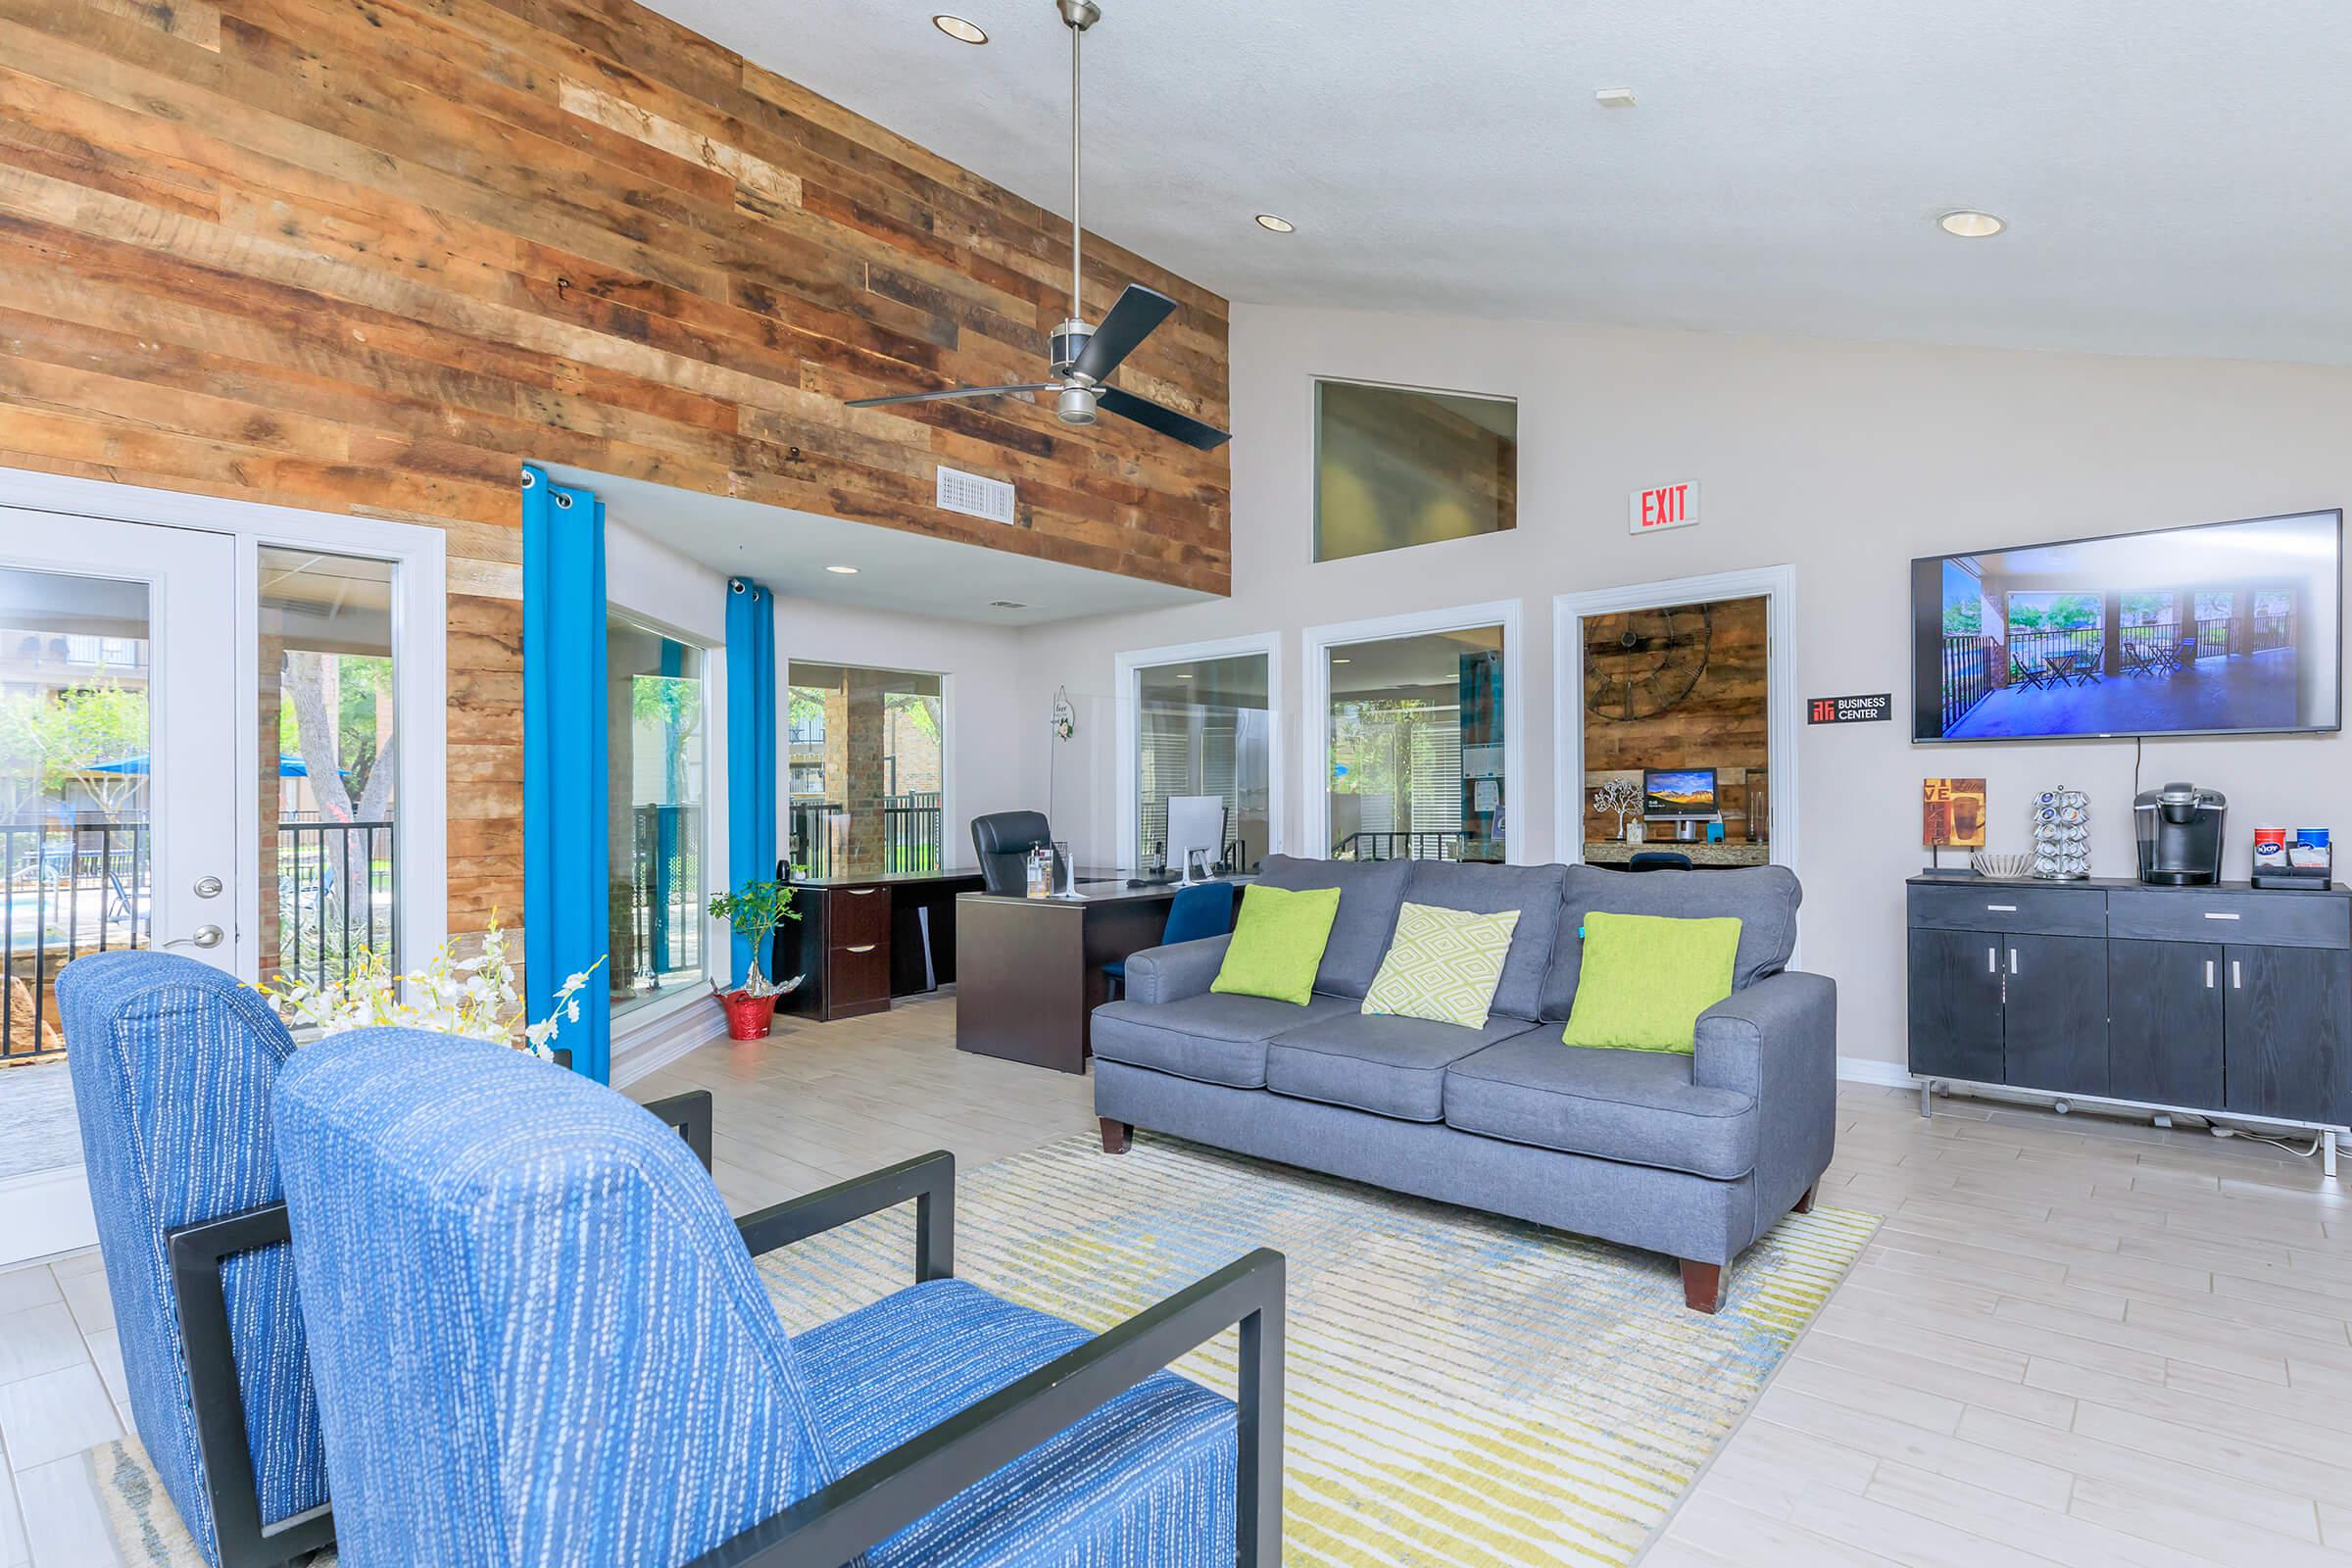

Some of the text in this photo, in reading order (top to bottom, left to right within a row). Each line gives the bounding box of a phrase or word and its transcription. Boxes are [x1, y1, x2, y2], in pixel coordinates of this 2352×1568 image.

[1642, 484, 1688, 526] EXIT
[1838, 697, 1886, 710] BUSINESS
[1838, 709, 1878, 720] CENTER
